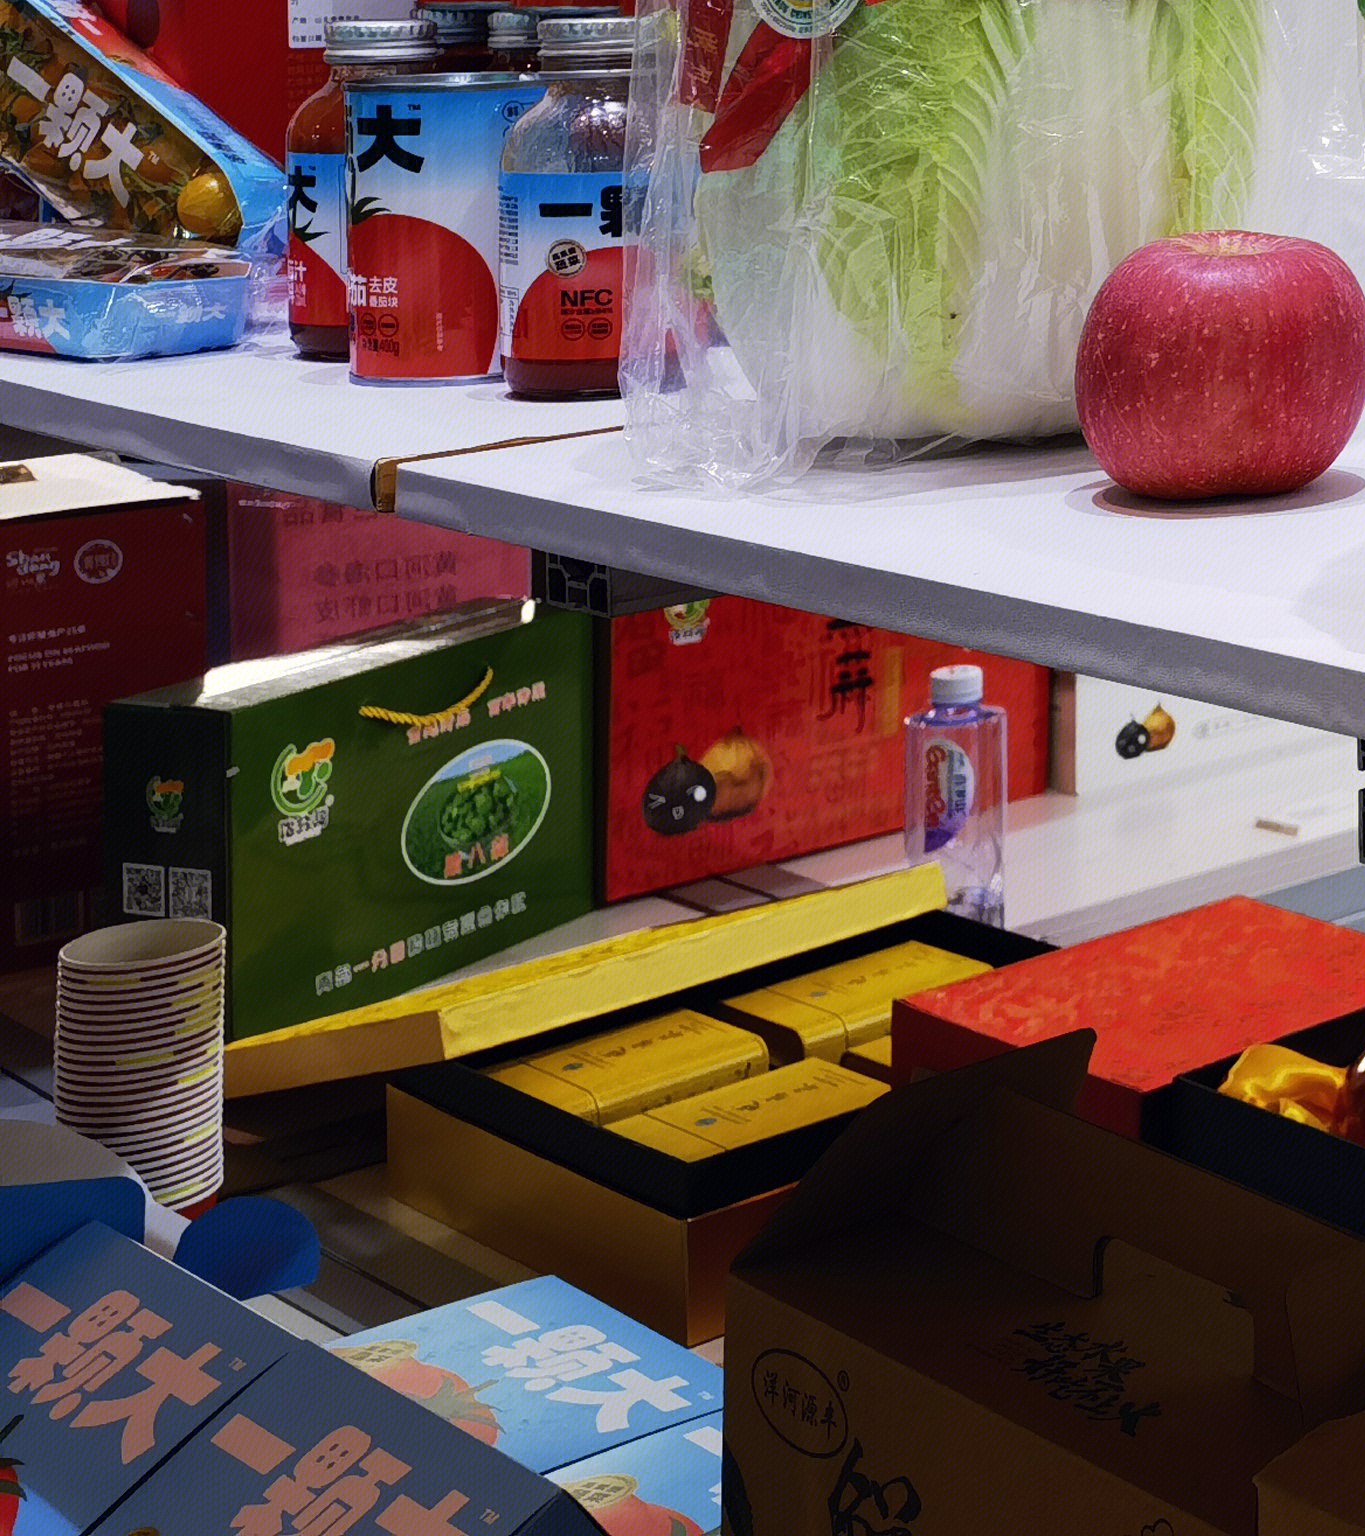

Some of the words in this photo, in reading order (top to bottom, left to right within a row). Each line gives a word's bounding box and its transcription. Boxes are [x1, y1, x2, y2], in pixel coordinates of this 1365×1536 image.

[6, 55, 145, 210] 一颗大
[356, 104, 425, 174] 大
[368, 275, 399, 294] 去皮
[560, 288, 614, 307] NFC
[0, 1281, 223, 1465] 一颗大
[465, 1299, 693, 1434] 一颗大
[762, 1369, 838, 1441] 洋河源丰
